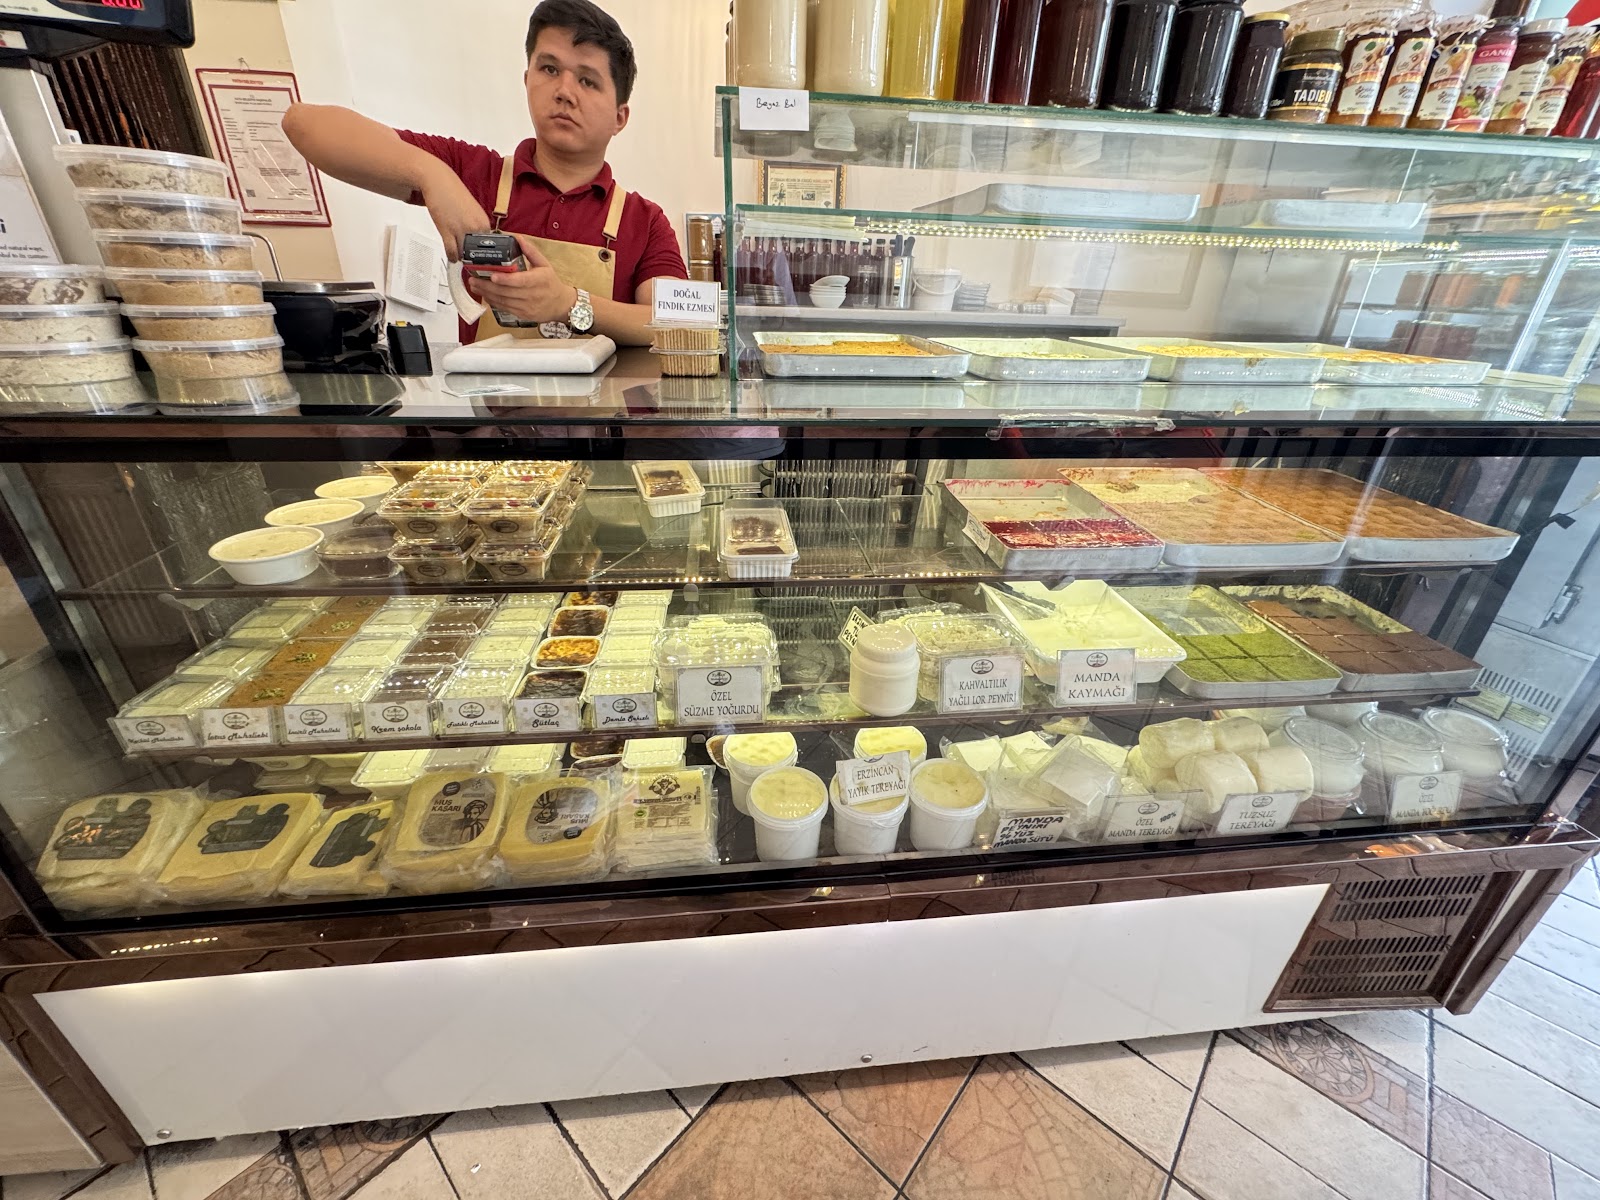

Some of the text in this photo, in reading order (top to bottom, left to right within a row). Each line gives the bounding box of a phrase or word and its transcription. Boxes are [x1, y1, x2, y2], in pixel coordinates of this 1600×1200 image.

[673, 288, 701, 300] DOĞAL
[658, 300, 716, 313] FINDIK EZMESİ
[1074, 672, 1121, 683] MANDA
[959, 678, 1008, 690] KAHVALTILIK
[710, 689, 732, 702] ÖZEL
[948, 690, 1017, 706] YAĞLI LOR PEYNİRİ
[1068, 685, 1126, 699] KAYMAĞI
[684, 703, 759, 717] SÜZME YOĞURDU
[531, 718, 560, 728] Sütlaç
[371, 725, 395, 734] Krem
[857, 764, 894, 780] ERZİNCAN
[847, 785, 870, 799] YAYIK
[1007, 816, 1064, 826] MANDA
[1239, 810, 1277, 820] TUZSUZ
[1135, 817, 1154, 826] ÖZEL
[1230, 818, 1276, 830] TEREYAĞI
[1107, 826, 1175, 838] MANDA TEREYAĞI
[1027, 834, 1055, 844] SÜTÜ
